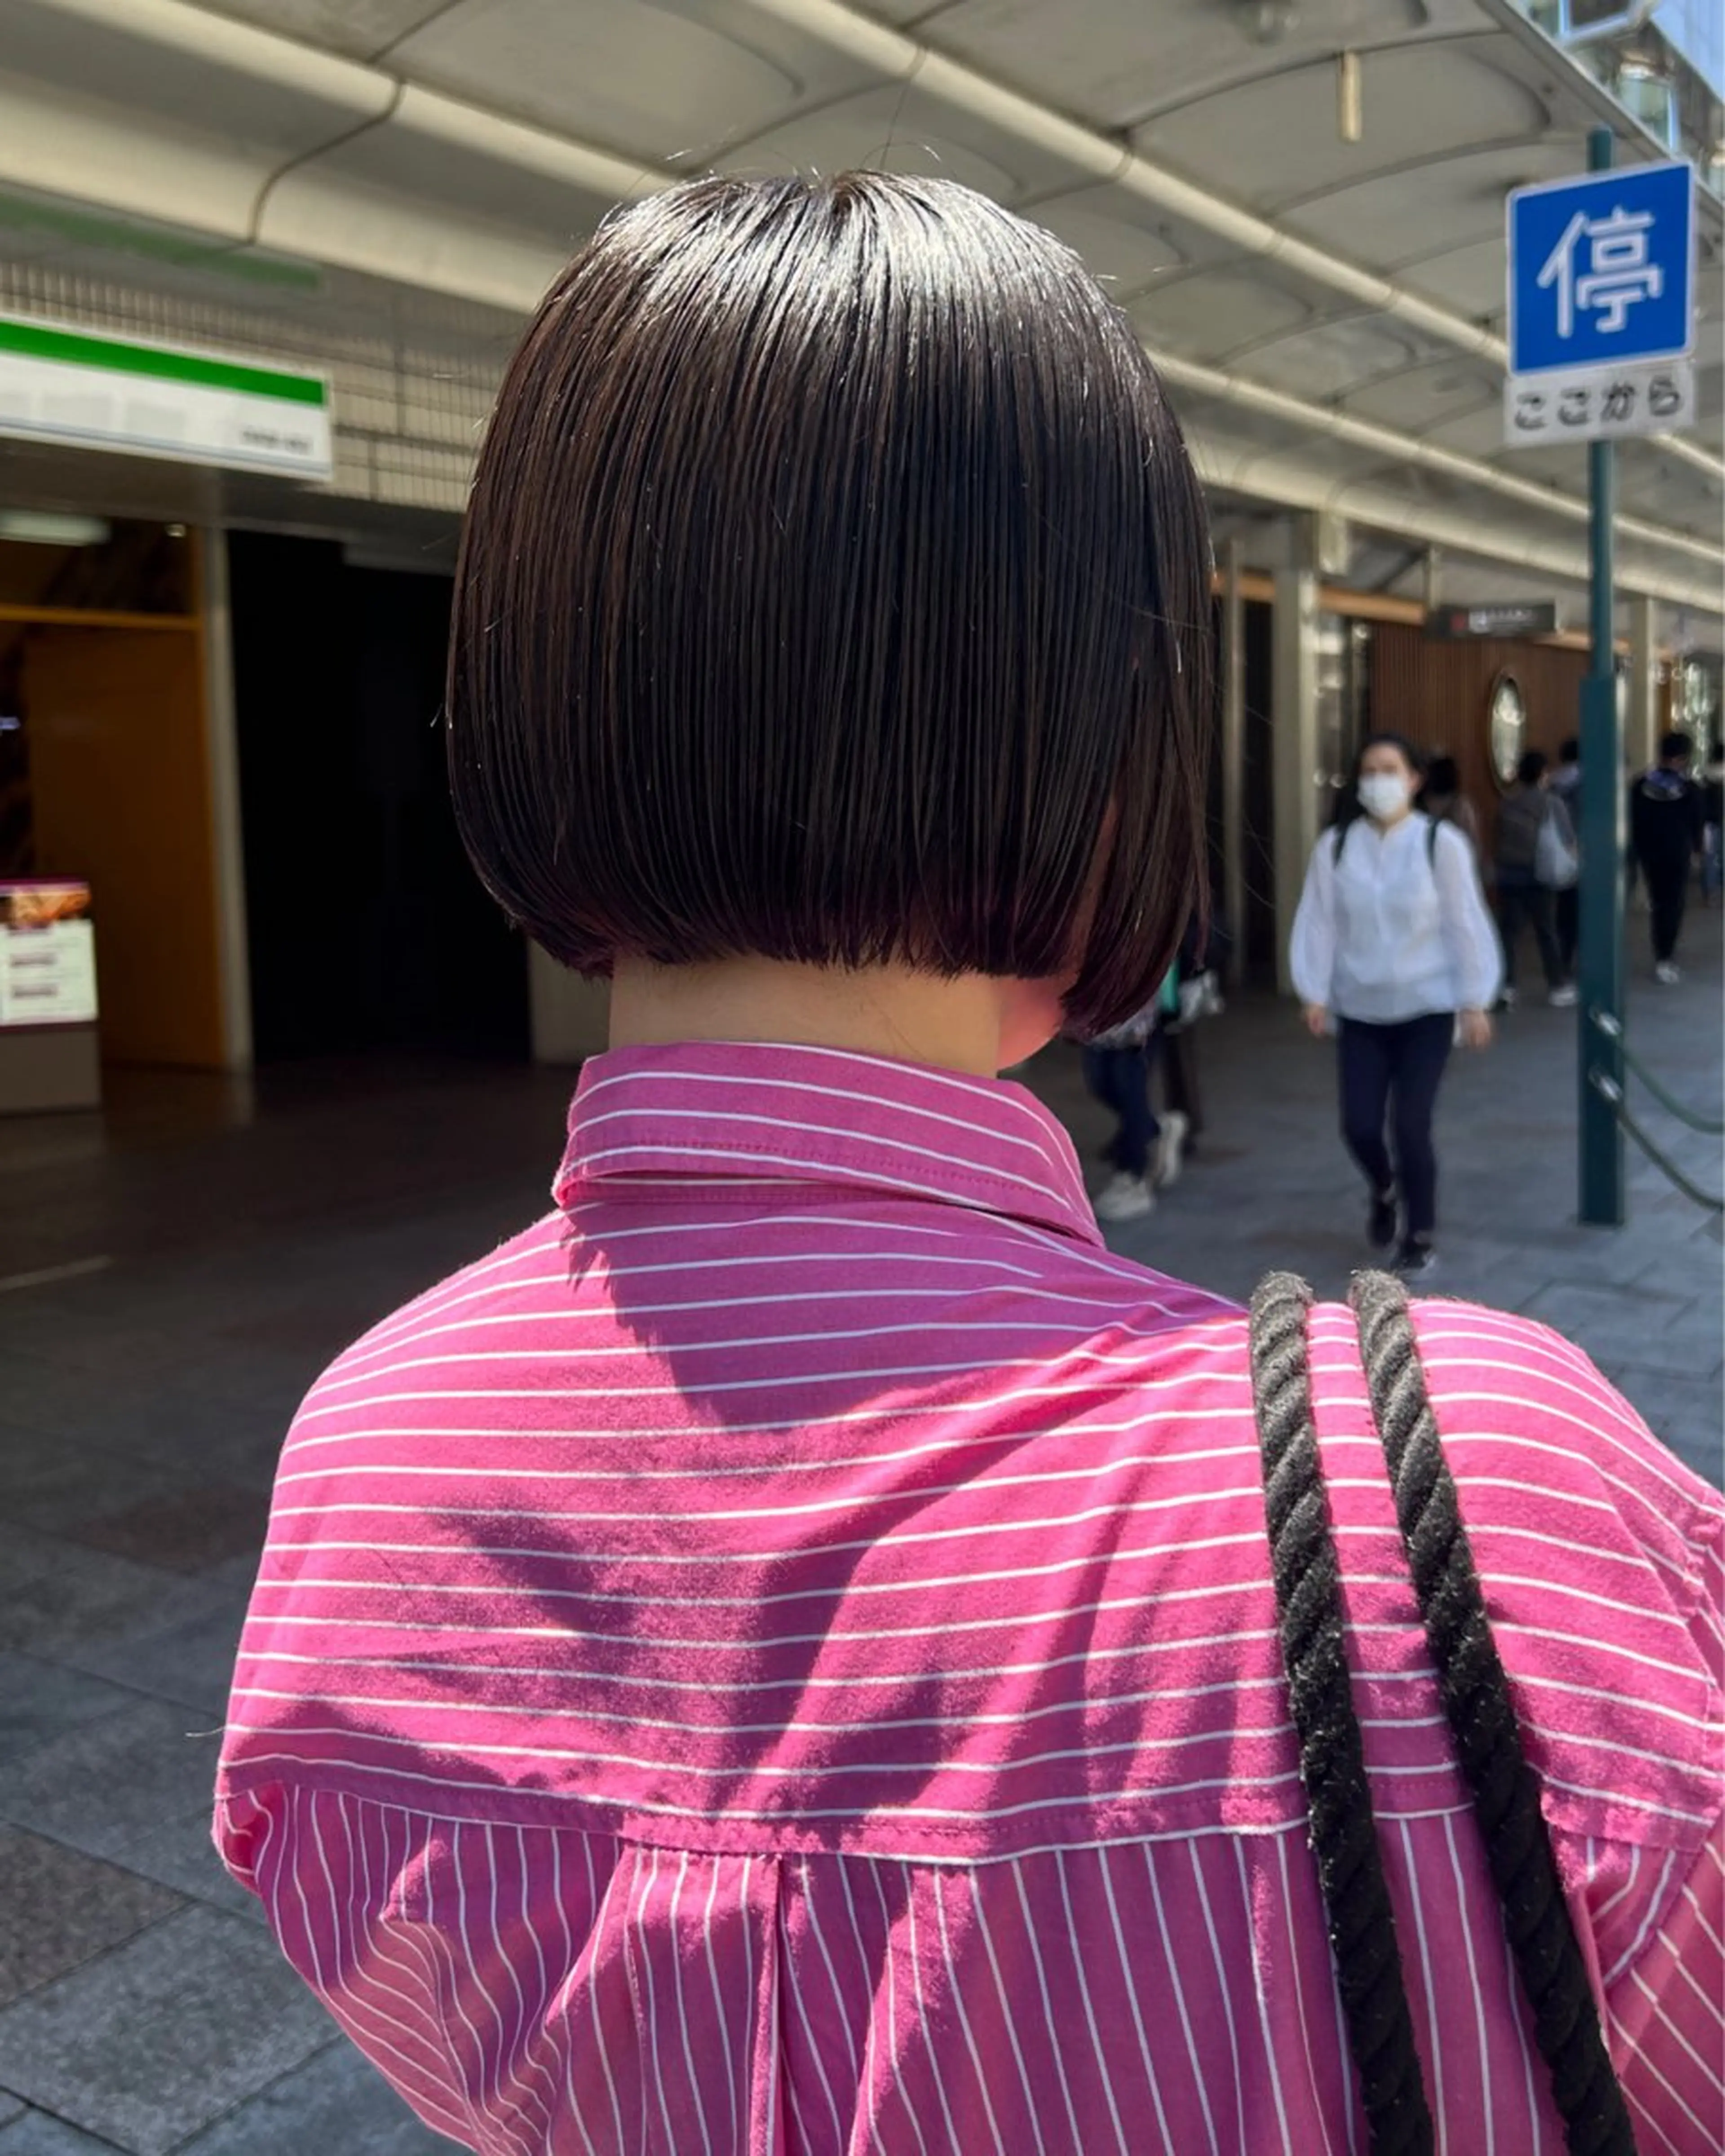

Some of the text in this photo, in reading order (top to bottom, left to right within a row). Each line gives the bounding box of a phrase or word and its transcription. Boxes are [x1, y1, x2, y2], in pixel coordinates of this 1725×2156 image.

[1537, 206, 1662, 338] 停
[1514, 376, 1682, 430] ここから
